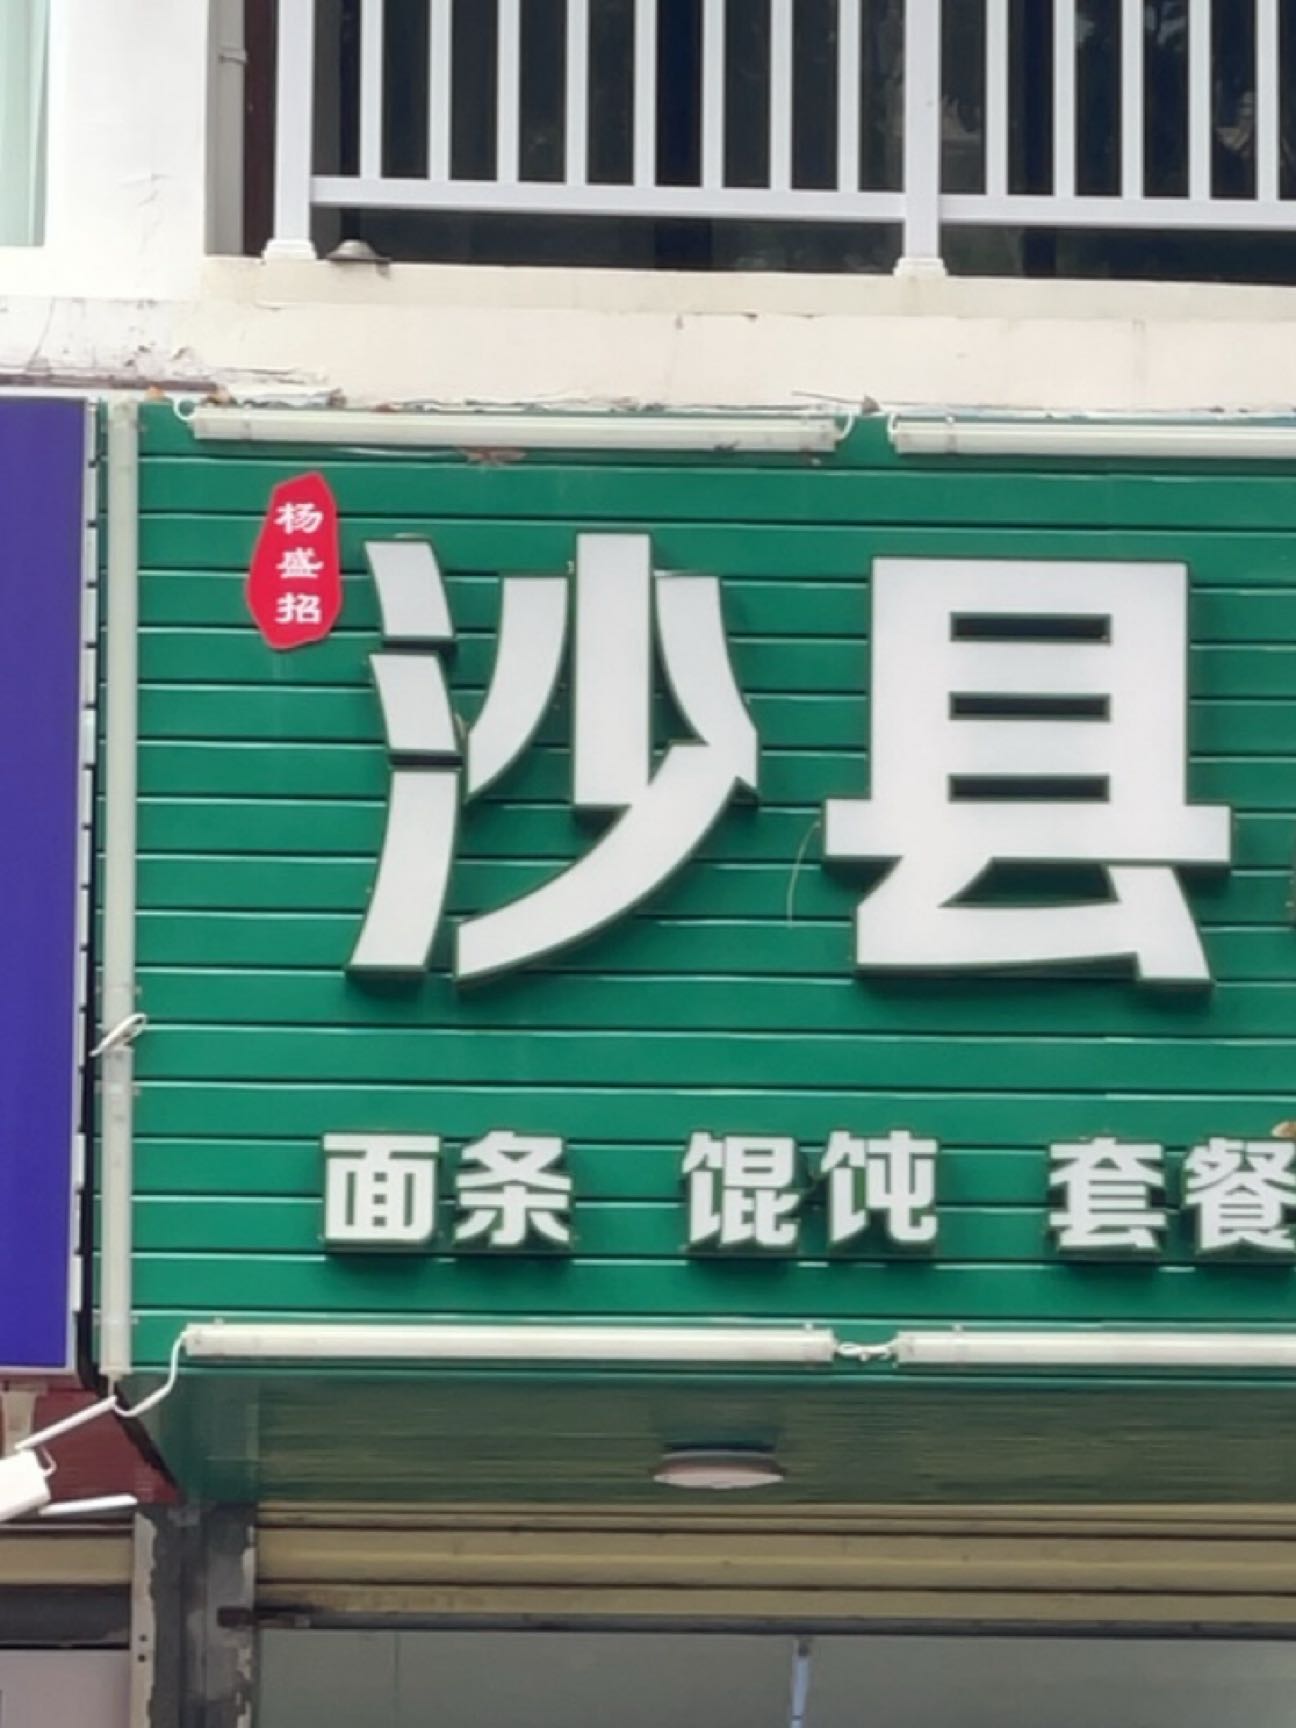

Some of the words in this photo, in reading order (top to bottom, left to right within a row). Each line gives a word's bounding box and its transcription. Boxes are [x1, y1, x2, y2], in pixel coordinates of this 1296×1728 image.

[274, 501, 325, 625] 杨盛招
[322, 1131, 572, 1246] 面条
[683, 1130, 938, 1247] 馄饨
